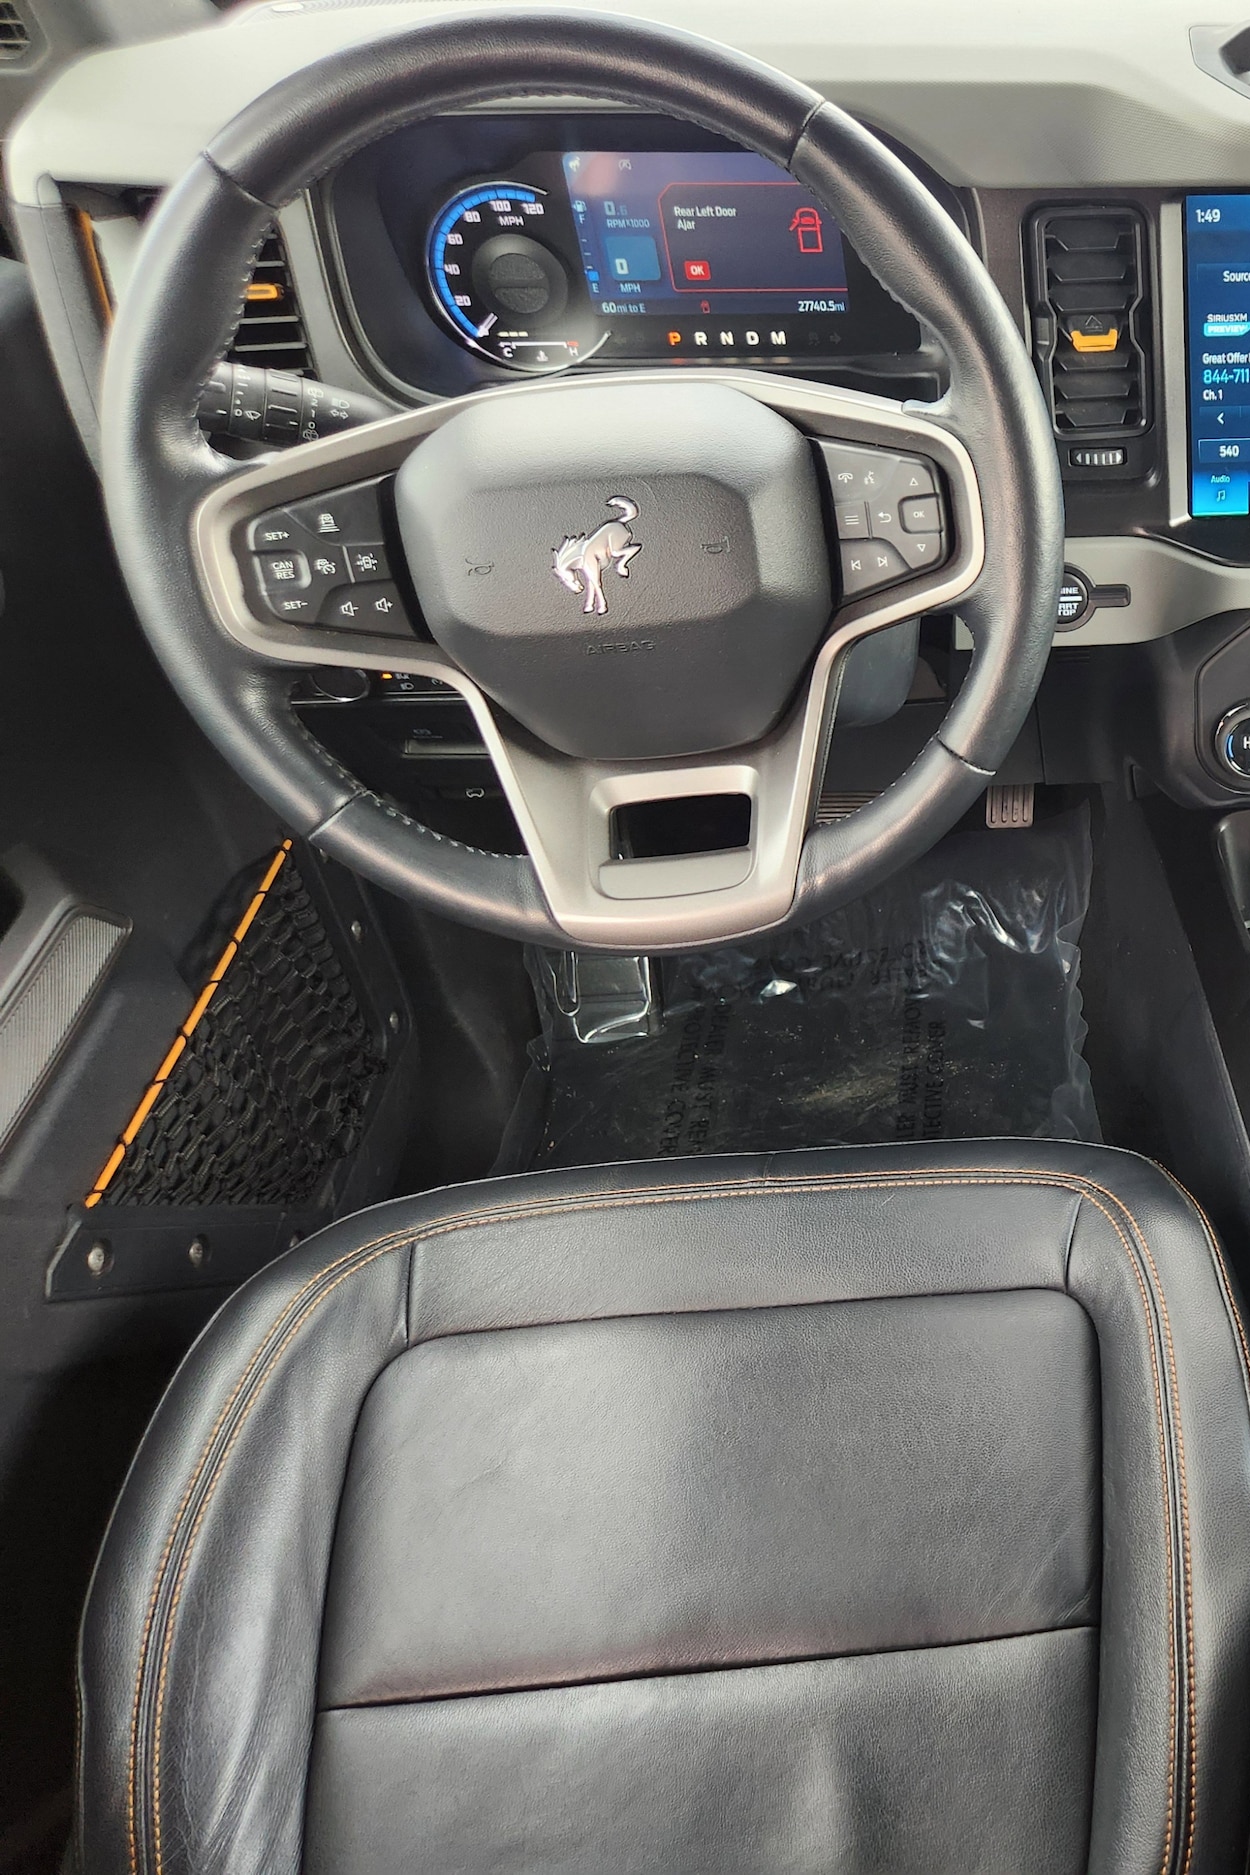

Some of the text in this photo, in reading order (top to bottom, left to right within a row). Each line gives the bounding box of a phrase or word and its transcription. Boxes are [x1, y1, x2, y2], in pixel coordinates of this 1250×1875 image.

[490, 200, 511, 212] 100
[522, 203, 544, 216] 120
[674, 206, 737, 217] Rear Left Door
[464, 211, 480, 223] 80
[499, 216, 524, 227] MPH
[578, 214, 586, 224] F
[1196, 209, 1221, 223] 1:49
[677, 219, 696, 231] Ajar
[447, 234, 464, 245] 60
[444, 264, 460, 275] 40
[615, 259, 629, 275] 0
[690, 265, 705, 276] OK
[592, 283, 600, 293] E
[619, 283, 641, 293] MPH
[455, 295, 471, 307] 20
[629, 303, 639, 313] to
[640, 303, 646, 313] E
[1207, 314, 1248, 322] SIRIUSXM
[668, 331, 787, 346] P R N D M
[502, 346, 579, 358] C H
[1202, 353, 1226, 364] Great
[1227, 352, 1248, 364] Offer
[1203, 389, 1223, 400] Ch. 1
[1219, 445, 1239, 457] 540
[1211, 474, 1230, 484] Audio
[913, 510, 925, 519] OK
[272, 561, 294, 569] CAN
[276, 571, 295, 580] RES
[586, 640, 656, 657] AIRBAG
[900, 1065, 919, 1104] MUST
